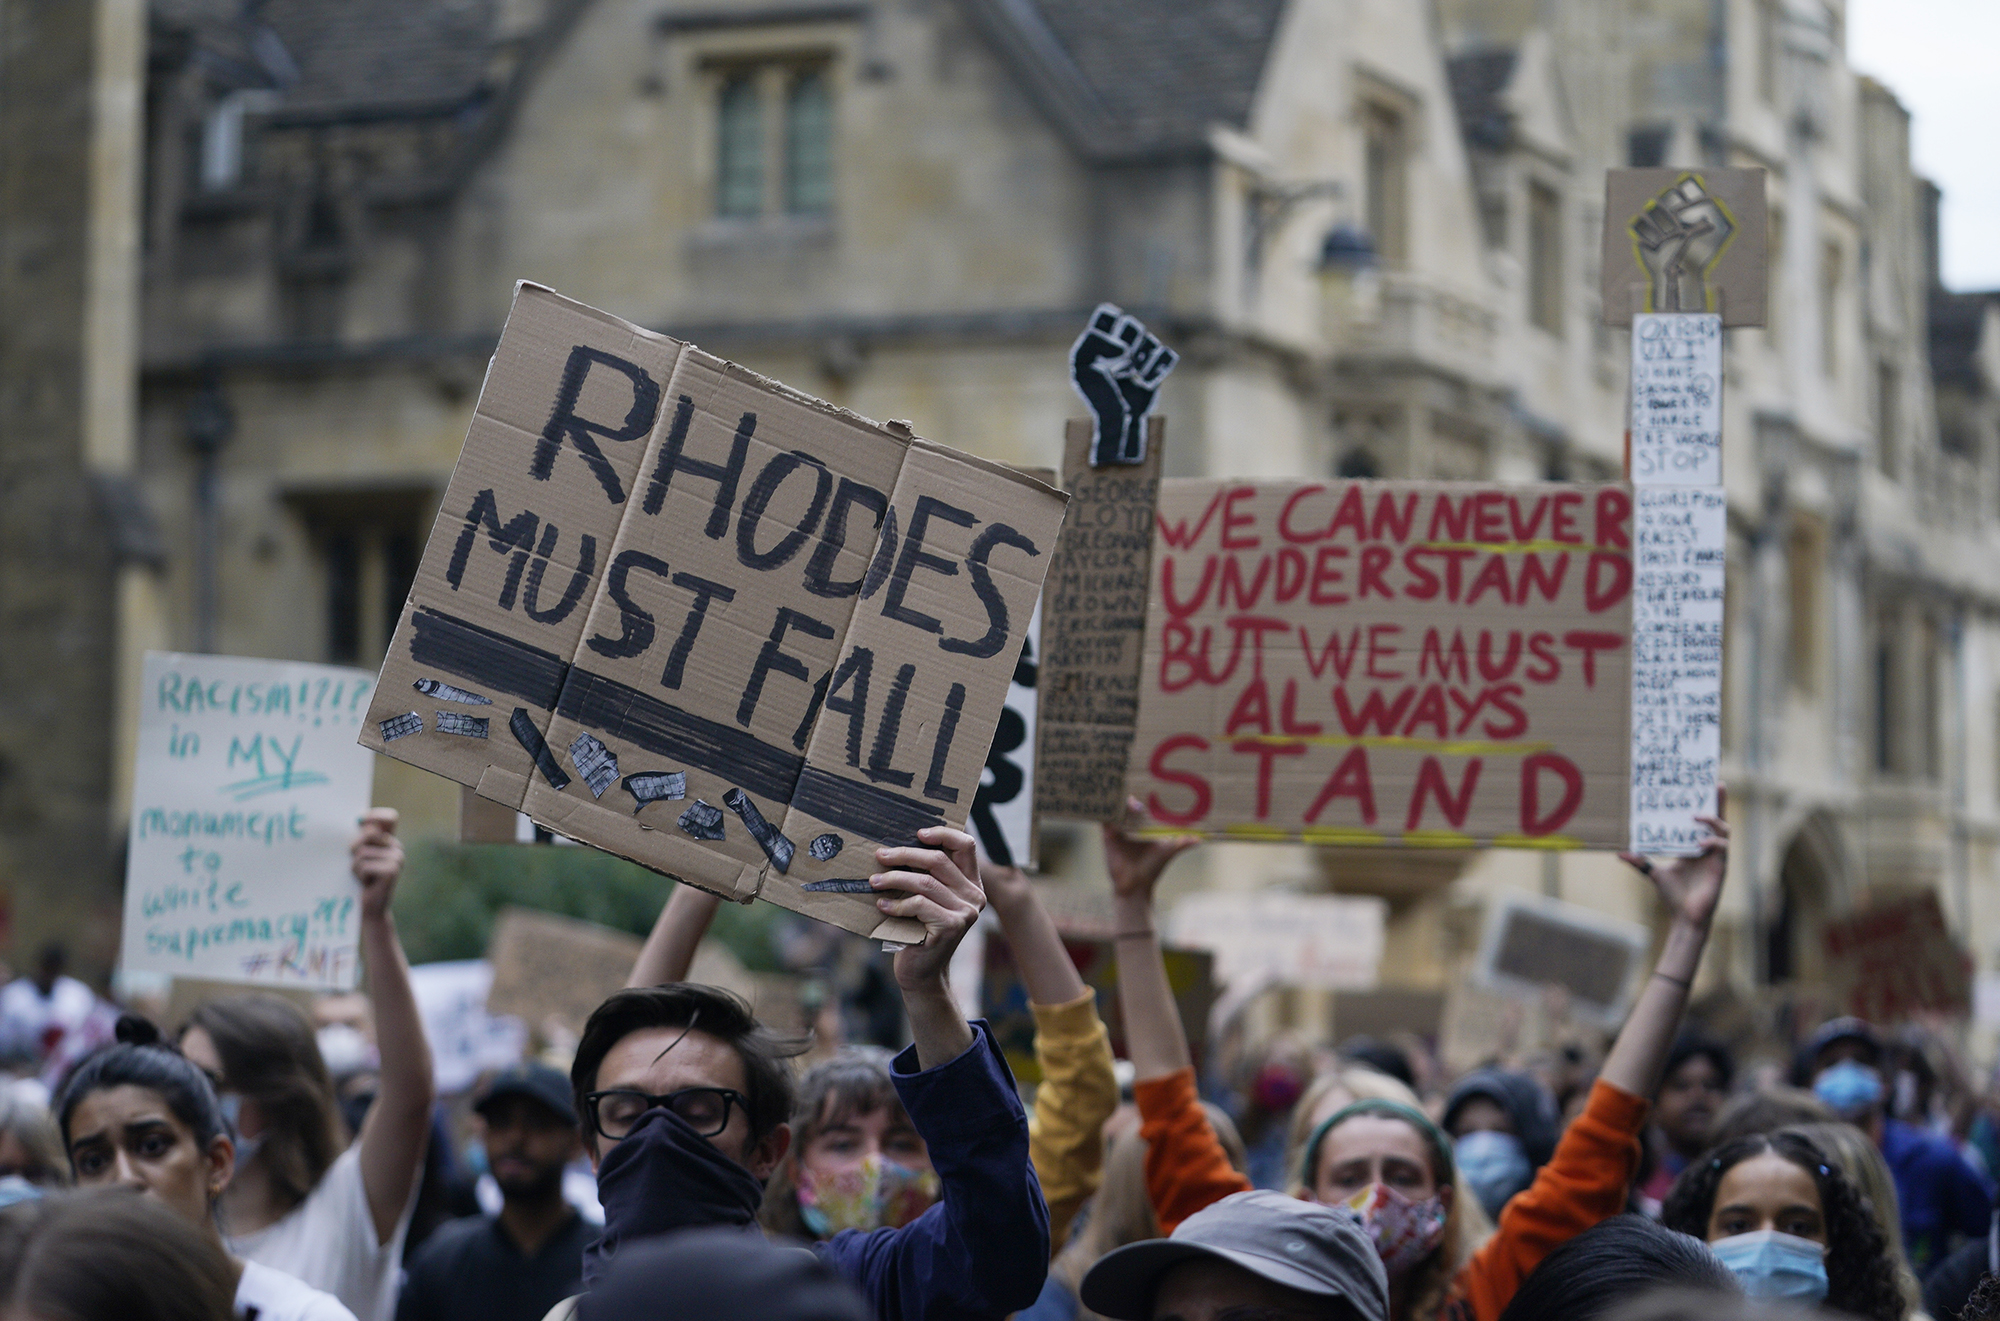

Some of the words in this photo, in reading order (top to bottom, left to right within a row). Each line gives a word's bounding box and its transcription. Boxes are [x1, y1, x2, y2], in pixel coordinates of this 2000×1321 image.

[1638, 444, 1709, 477] STOP
[527, 344, 1040, 659] RHODES
[1156, 487, 1261, 550] WE
[1277, 485, 1419, 544] CAN
[1427, 489, 1632, 549] NEVER
[1161, 546, 1633, 620] UNDERSTAND
[444, 488, 736, 690] MUST
[735, 606, 965, 803] FALL
[1159, 614, 1291, 693] BUT
[1299, 625, 1405, 680] WE
[1419, 626, 1625, 689] MUST
[1224, 677, 1530, 741] ALWAYS
[168, 723, 200, 758] in
[227, 732, 303, 789] MY
[1147, 732, 1585, 838] STAND
[178, 846, 223, 874] to
